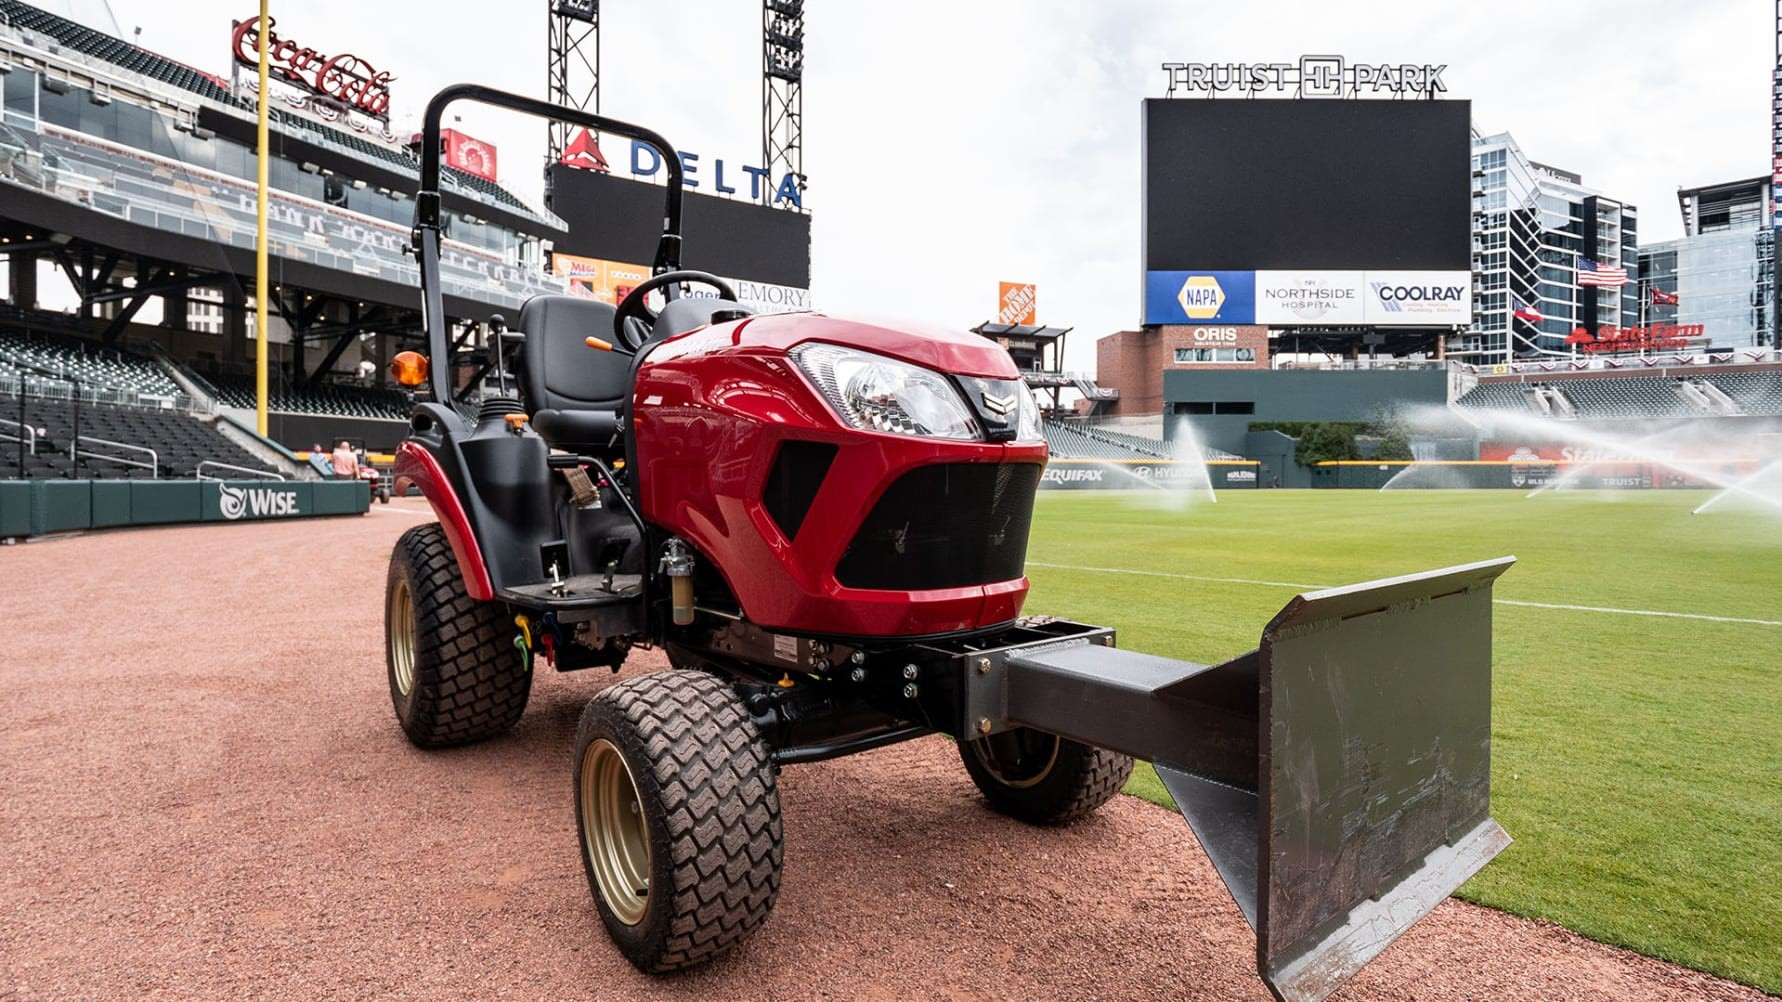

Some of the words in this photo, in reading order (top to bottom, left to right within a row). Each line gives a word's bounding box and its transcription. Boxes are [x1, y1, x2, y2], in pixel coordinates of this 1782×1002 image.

[232, 15, 399, 115] Coca-Cola
[1161, 62, 1292, 91] TRUIST
[1353, 63, 1449, 92] PARK
[630, 138, 802, 207] DELTA
[738, 281, 807, 307] EMORY
[1186, 288, 1218, 306] NAPA
[1265, 288, 1355, 299] NORTHSIDE
[1379, 286, 1465, 301] COOLRAY
[999, 284, 1035, 323] HOME
[1281, 301, 1339, 309] HOSPITAL
[1193, 327, 1238, 342] ORIS
[1041, 469, 1104, 484] EQUIFAX
[1603, 477, 1641, 486] TRUIST
[248, 488, 297, 516] WISE
